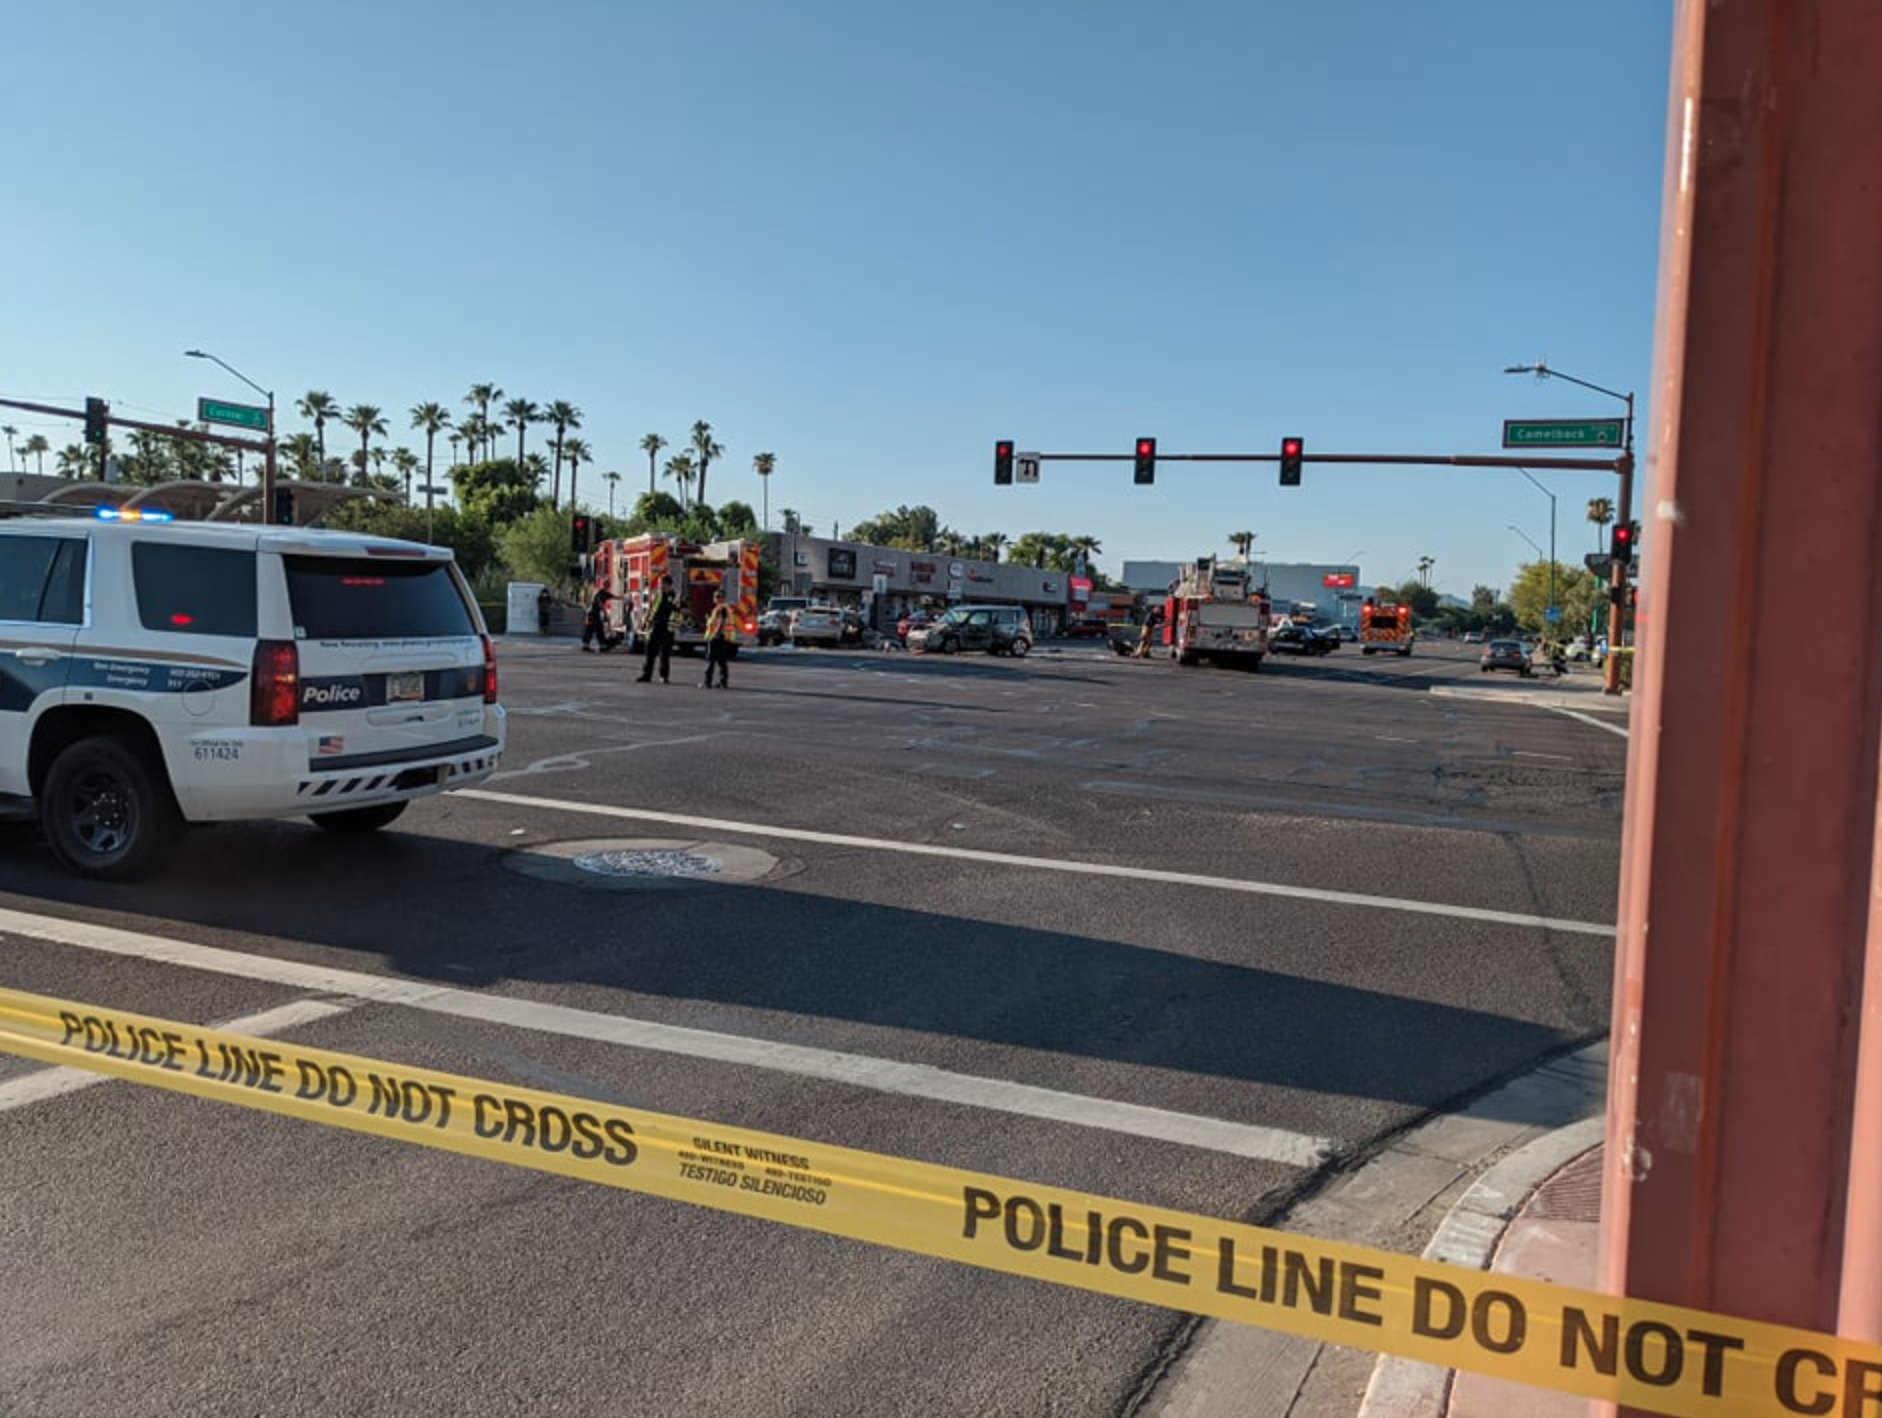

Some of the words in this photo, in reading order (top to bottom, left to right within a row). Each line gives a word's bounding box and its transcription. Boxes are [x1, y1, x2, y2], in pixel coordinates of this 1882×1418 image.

[1517, 428, 1585, 439] Camelback
[302, 684, 361, 703] Police
[195, 747, 239, 760] 611424
[59, 1011, 186, 1071] POLICE
[195, 1039, 285, 1092] LINE
[295, 1058, 358, 1107] DO
[367, 1073, 456, 1128] NOT
[474, 1094, 638, 1165] CROSS
[692, 1137, 742, 1157] SILENT
[744, 1146, 810, 1170] WITNESS
[679, 1162, 738, 1187] TESTIGO
[740, 1175, 827, 1205] SILENCIOSO
[962, 1186, 1192, 1285] POLICE
[1216, 1237, 1384, 1326] LINE
[1411, 1276, 1527, 1355] DO
[1559, 1306, 1744, 1397] NOT
